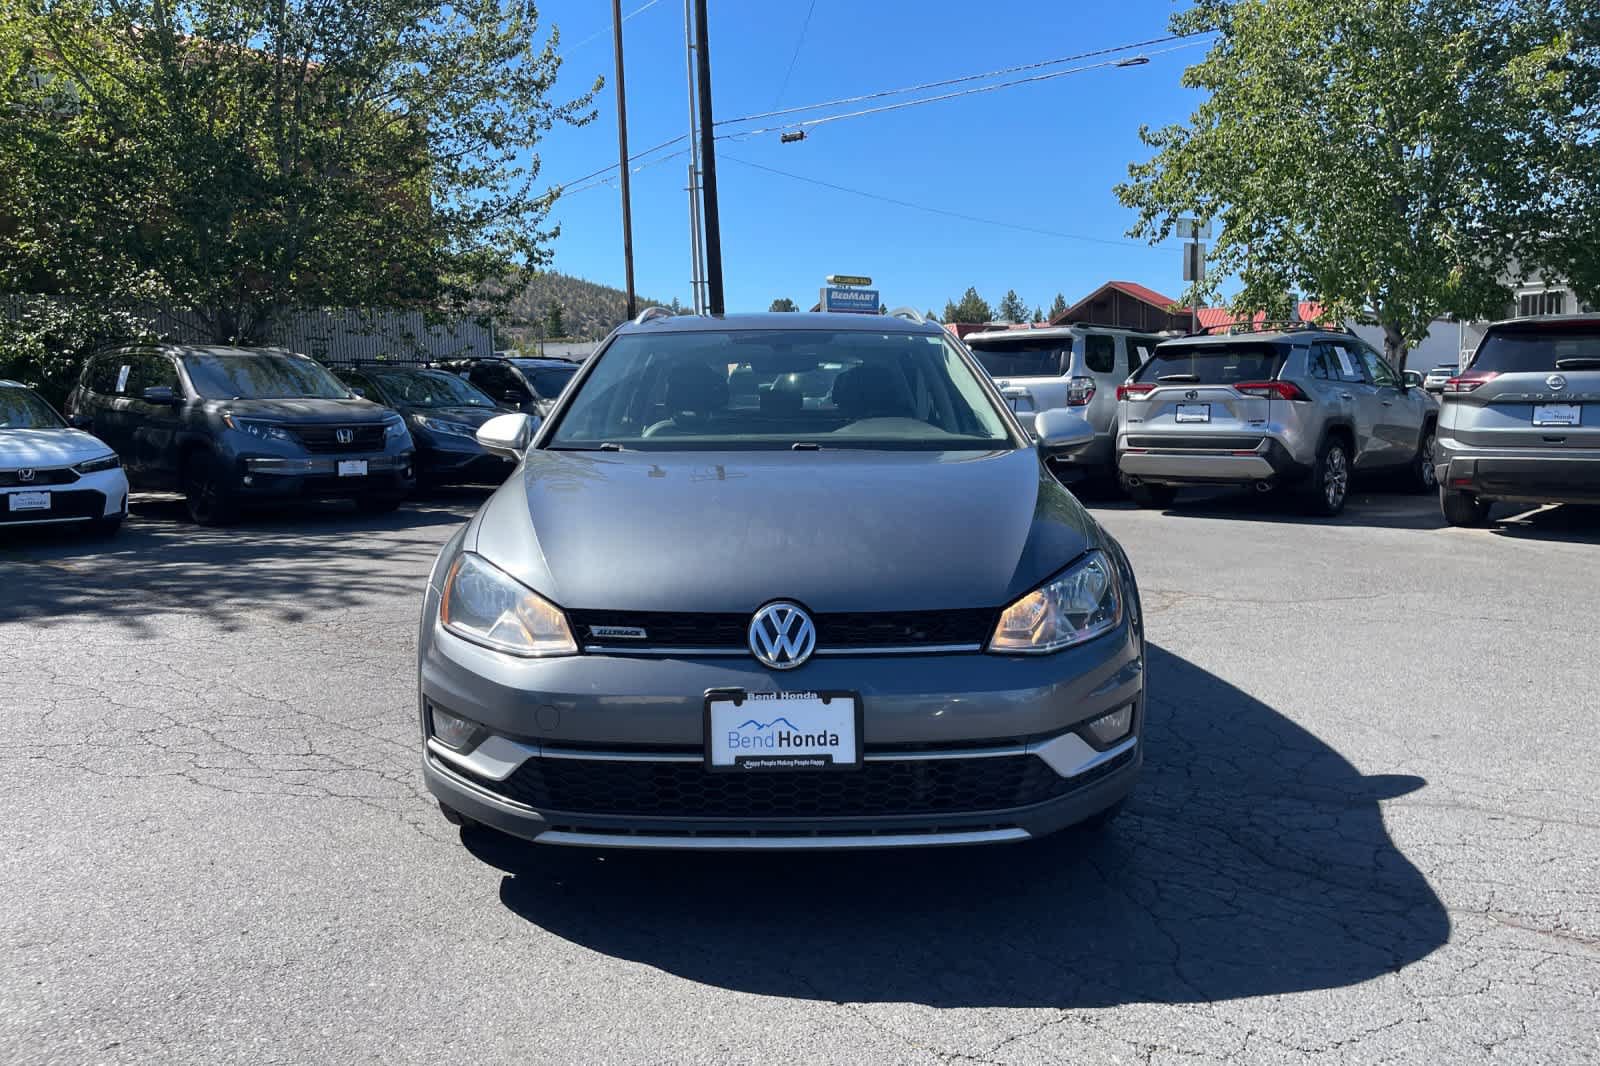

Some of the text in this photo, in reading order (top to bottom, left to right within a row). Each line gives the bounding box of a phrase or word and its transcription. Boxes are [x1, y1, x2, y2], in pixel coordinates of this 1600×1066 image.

[747, 691, 818, 700] Bend Honda
[728, 730, 839, 749] Bend Honda
